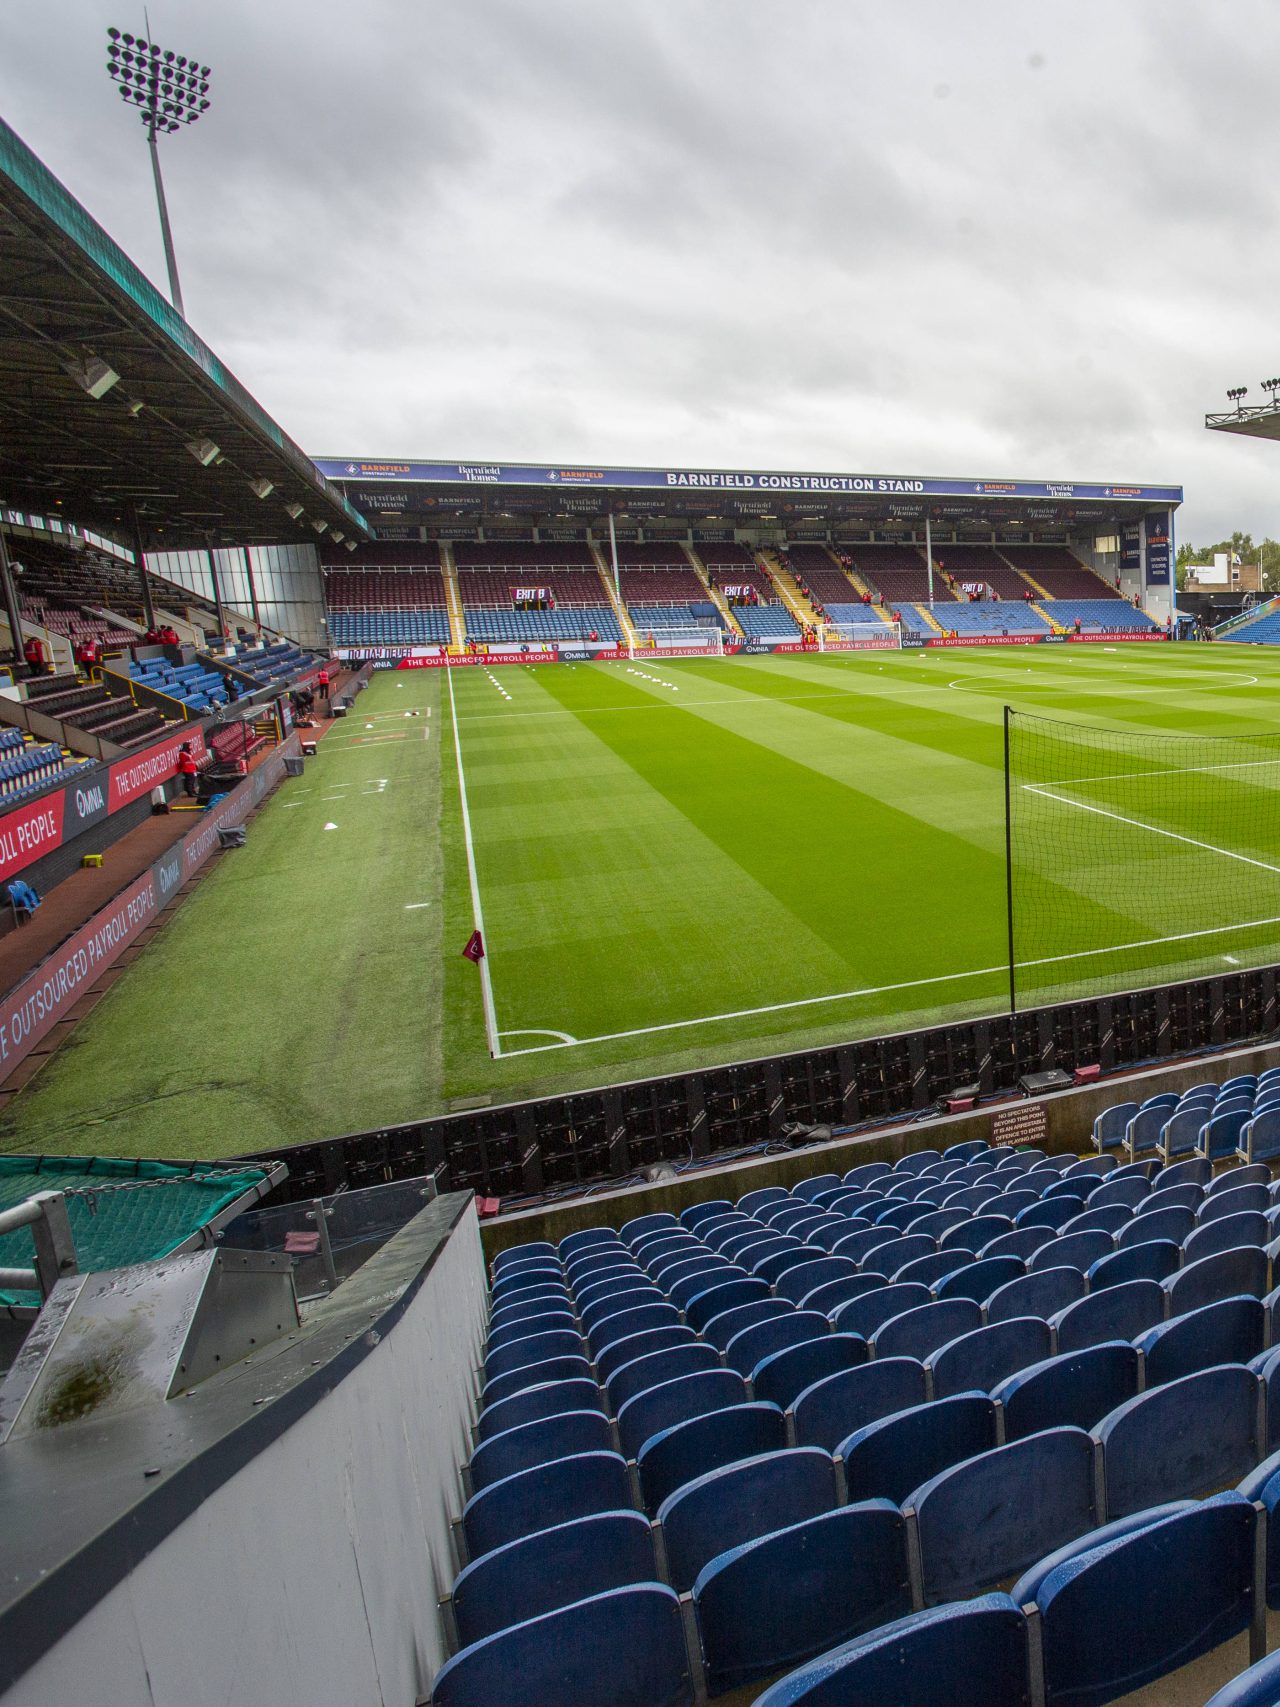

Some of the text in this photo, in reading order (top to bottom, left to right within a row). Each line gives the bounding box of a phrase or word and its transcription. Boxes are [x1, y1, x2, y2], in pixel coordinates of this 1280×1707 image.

[361, 464, 410, 473] BARNFIELD
[458, 466, 500, 475] Barnfield
[466, 473, 498, 482] Homes
[560, 471, 603, 479] BARNFIELD
[667, 474, 924, 492] BARNFIELD CONSTRUCTION STAND
[1046, 484, 1074, 492] Barnfield
[360, 493, 408, 502] Barnfield
[559, 497, 602, 506] Barnfield
[369, 500, 405, 508] Homes
[725, 586, 750, 596] EXIT C
[962, 584, 976, 592] EXIT
[516, 588, 545, 599] EXIT B
[746, 645, 769, 653] OMNIA
[798, 642, 840, 651] OUTSOURCED
[618, 649, 670, 657] OUTSOURCED
[672, 648, 704, 656] PAYROLL
[706, 647, 732, 655] PEOPLE
[426, 656, 484, 665] OUTSOURCED
[487, 655, 527, 663] PAYROLL
[529, 653, 554, 661] PEOPLE
[372, 660, 392, 668] MNIA
[116, 775, 130, 796] THE
[130, 752, 167, 788] OUTSOURCED
[76, 786, 104, 818] OMNIA
[17, 810, 56, 852] PEOPLE
[186, 846, 197, 866] THE
[159, 860, 180, 893] OMNIA
[12, 948, 88, 1045] OUTSOURCED
[88, 911, 128, 966] PAYROLL
[128, 884, 154, 928] PEOPLE
[1008, 1105, 1040, 1117] SPECTATORS
[994, 1119, 1016, 1127] BEYOND
[1014, 1118, 1046, 1130] ARRESTABLE
[996, 1131, 1020, 1141] OFFENCE
[1008, 1136, 1029, 1145] PLAYING
